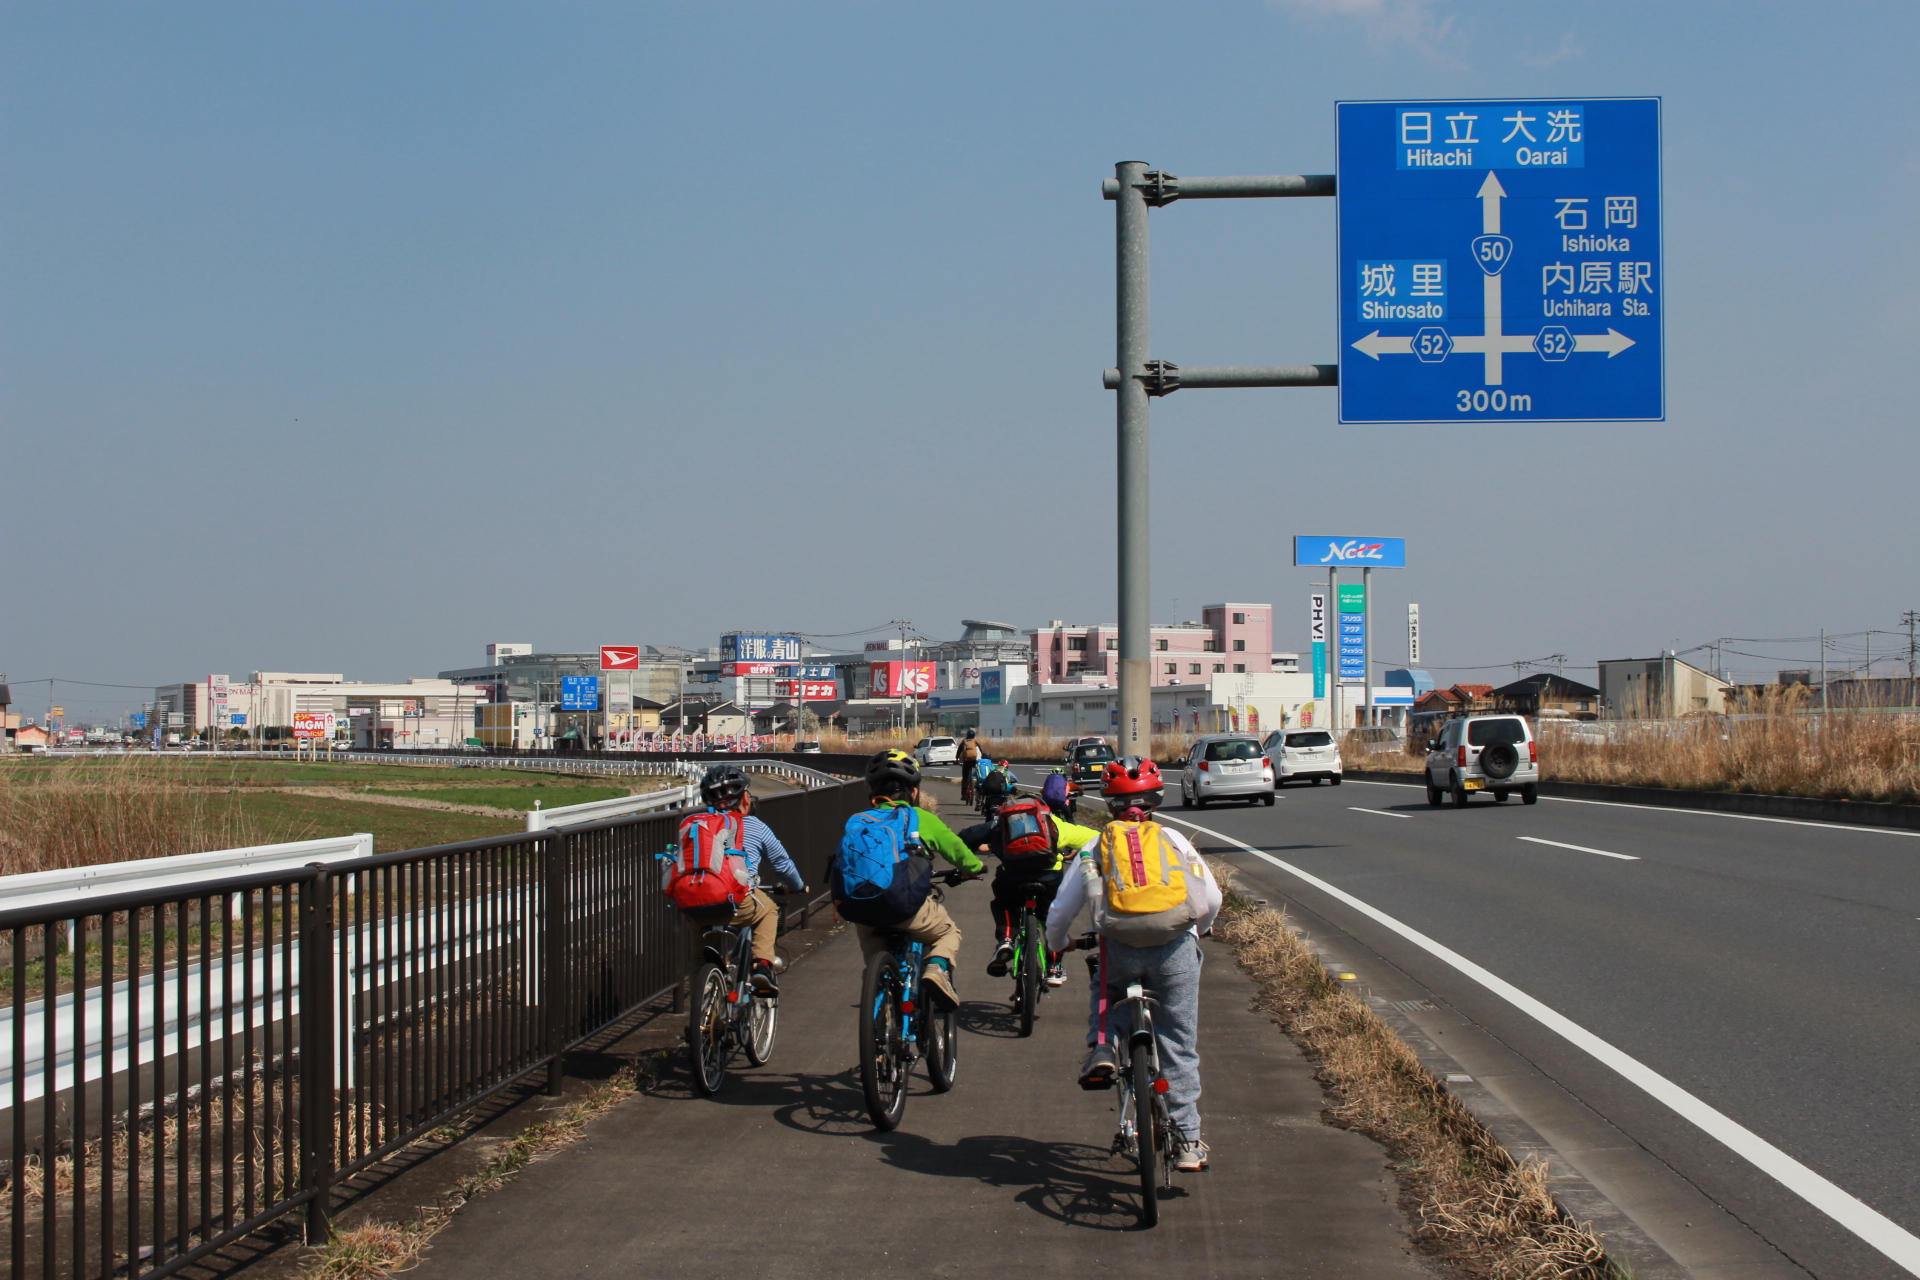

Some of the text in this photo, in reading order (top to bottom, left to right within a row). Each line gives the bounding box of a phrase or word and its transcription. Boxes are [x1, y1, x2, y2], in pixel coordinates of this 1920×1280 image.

[1402, 109, 1581, 144] 日立 大洗
[1406, 149, 1472, 166] Hitachi
[1516, 147, 1567, 165] Oarai
[1554, 196, 1637, 229] 石岡
[1480, 241, 1504, 261] 50
[1562, 234, 1630, 252] Ishioka
[1360, 263, 1444, 297] 城里
[1542, 261, 1653, 295] 内原駅
[1362, 300, 1443, 319] Shirosato
[1543, 298, 1650, 317] Uchihara Sta.
[1420, 334, 1443, 355] 52
[1543, 333, 1566, 353] 52
[1456, 389, 1531, 412] 300m
[1320, 540, 1384, 562] Netz
[1312, 596, 1323, 640] PHV!
[741, 638, 799, 660] 洋服の青山
[296, 720, 324, 730] MGM
